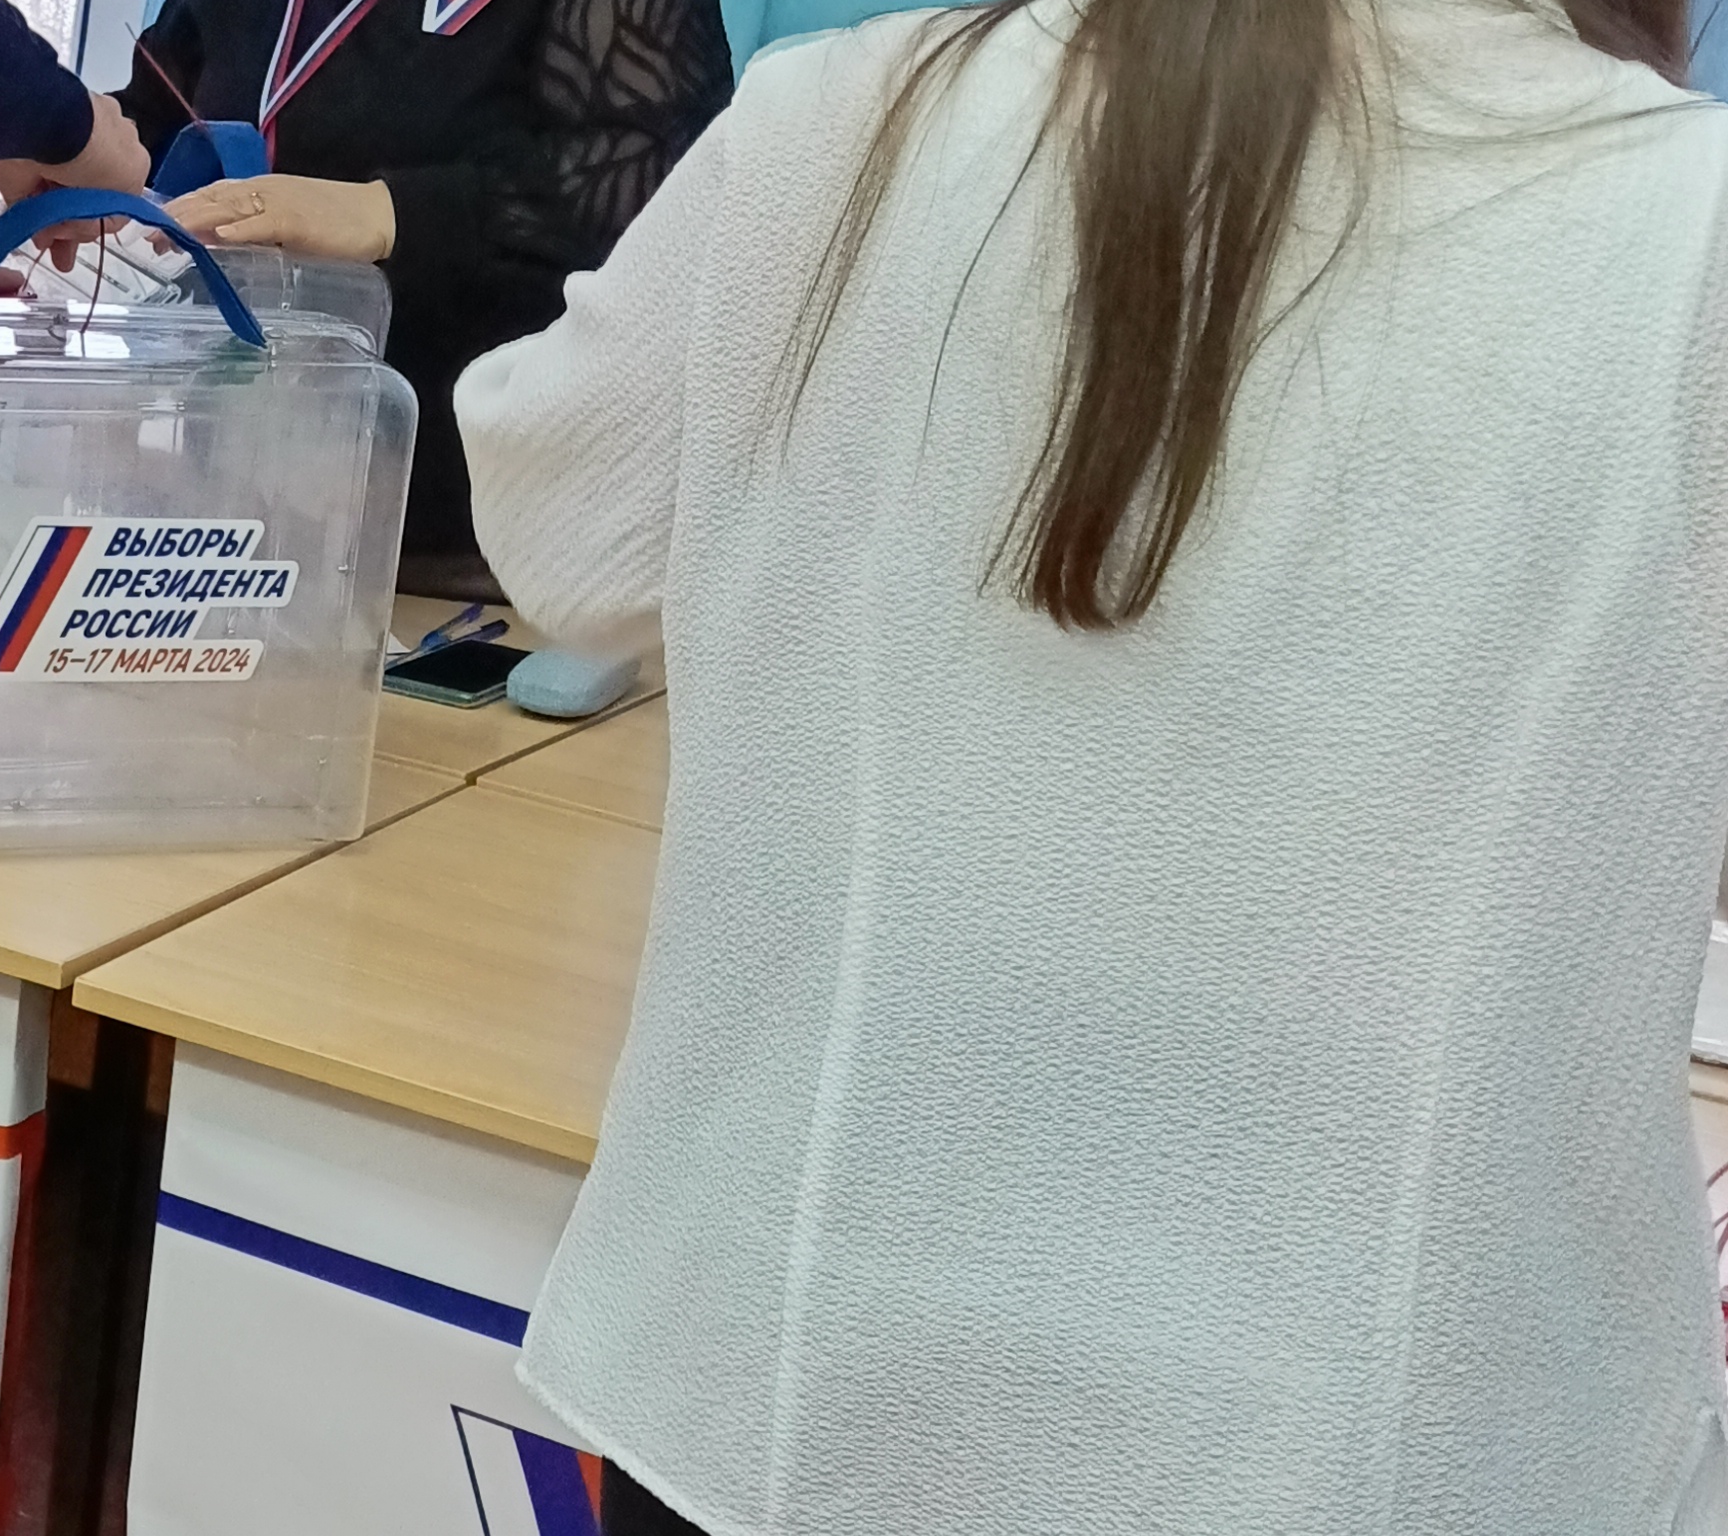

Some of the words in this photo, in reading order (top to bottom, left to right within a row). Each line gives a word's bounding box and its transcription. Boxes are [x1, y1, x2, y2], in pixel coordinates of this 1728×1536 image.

[104, 527, 255, 558] ВЫБОРЫ
[82, 568, 290, 602] ПРЕЗИДЕНТА
[60, 609, 198, 639] РОССИИ
[110, 648, 194, 673] МАРТА
[192, 648, 252, 673] 2024
